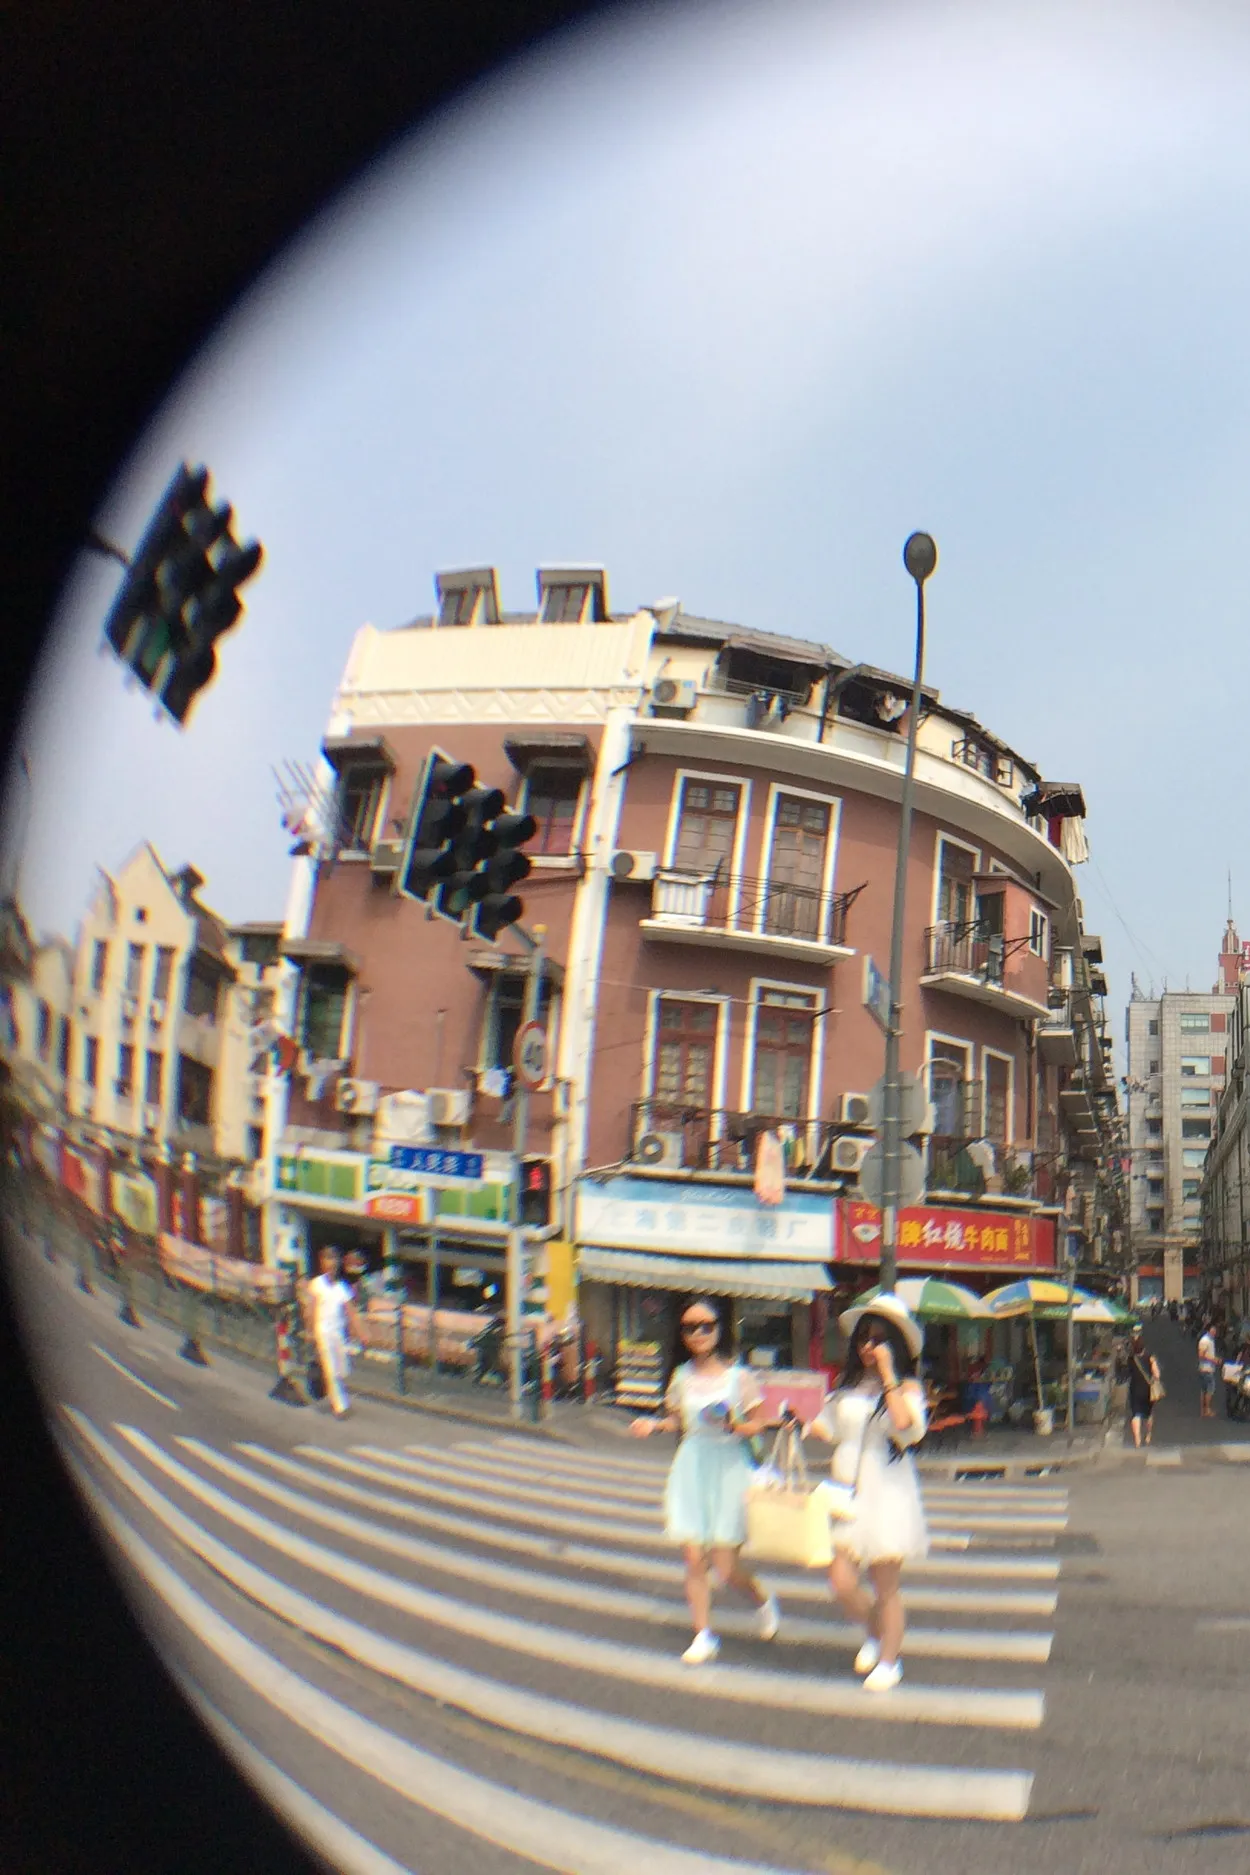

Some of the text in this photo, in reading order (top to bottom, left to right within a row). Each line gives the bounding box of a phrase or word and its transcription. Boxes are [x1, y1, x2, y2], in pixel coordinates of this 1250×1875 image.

[896, 1218, 1009, 1252] 牌红烧牛肉面
